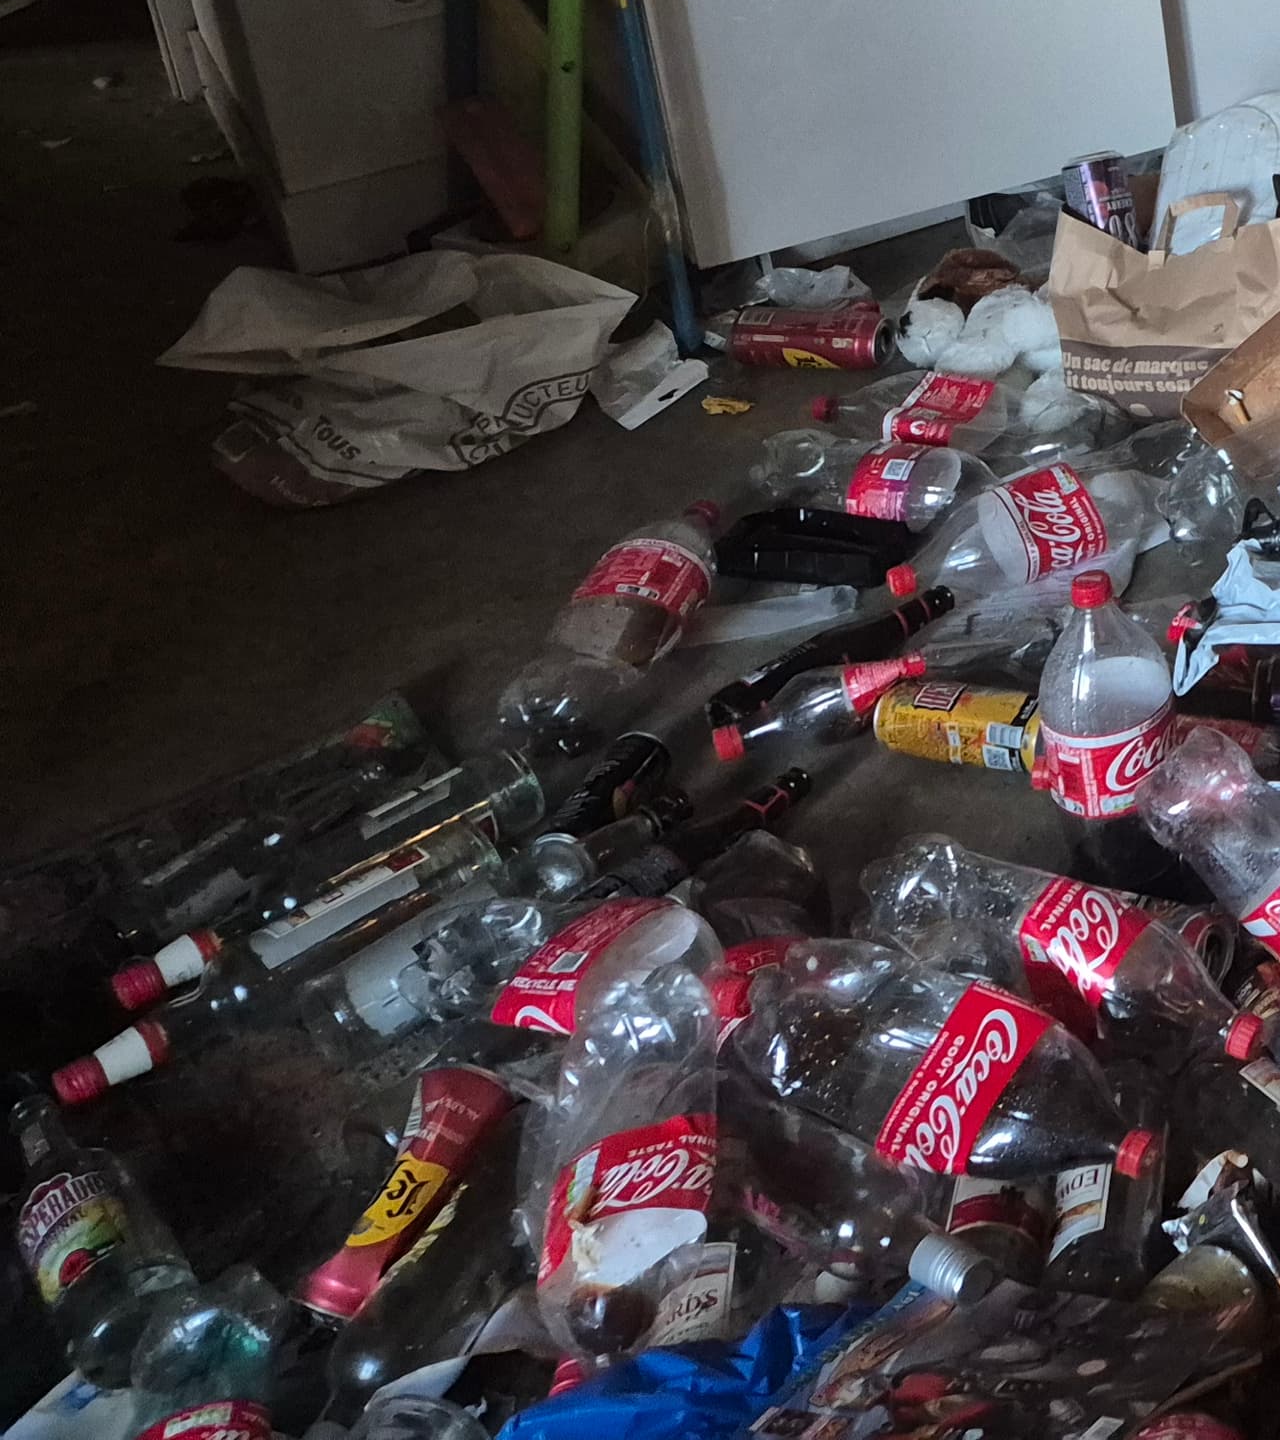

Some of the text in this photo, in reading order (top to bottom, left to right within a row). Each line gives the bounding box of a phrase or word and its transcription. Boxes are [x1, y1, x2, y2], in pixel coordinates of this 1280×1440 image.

[1063, 351, 1083, 370] Un
[1084, 356, 1111, 372] sac
[1112, 357, 1131, 374] de
[1080, 373, 1155, 395] toujours
[512, 975, 558, 991] RECYCLE
[935, 1034, 966, 1079] GOÛT
[903, 1008, 1019, 1175] Coca-Col
[889, 1079, 939, 1153] ORIGINAL
[626, 1139, 675, 1158] TASTE
